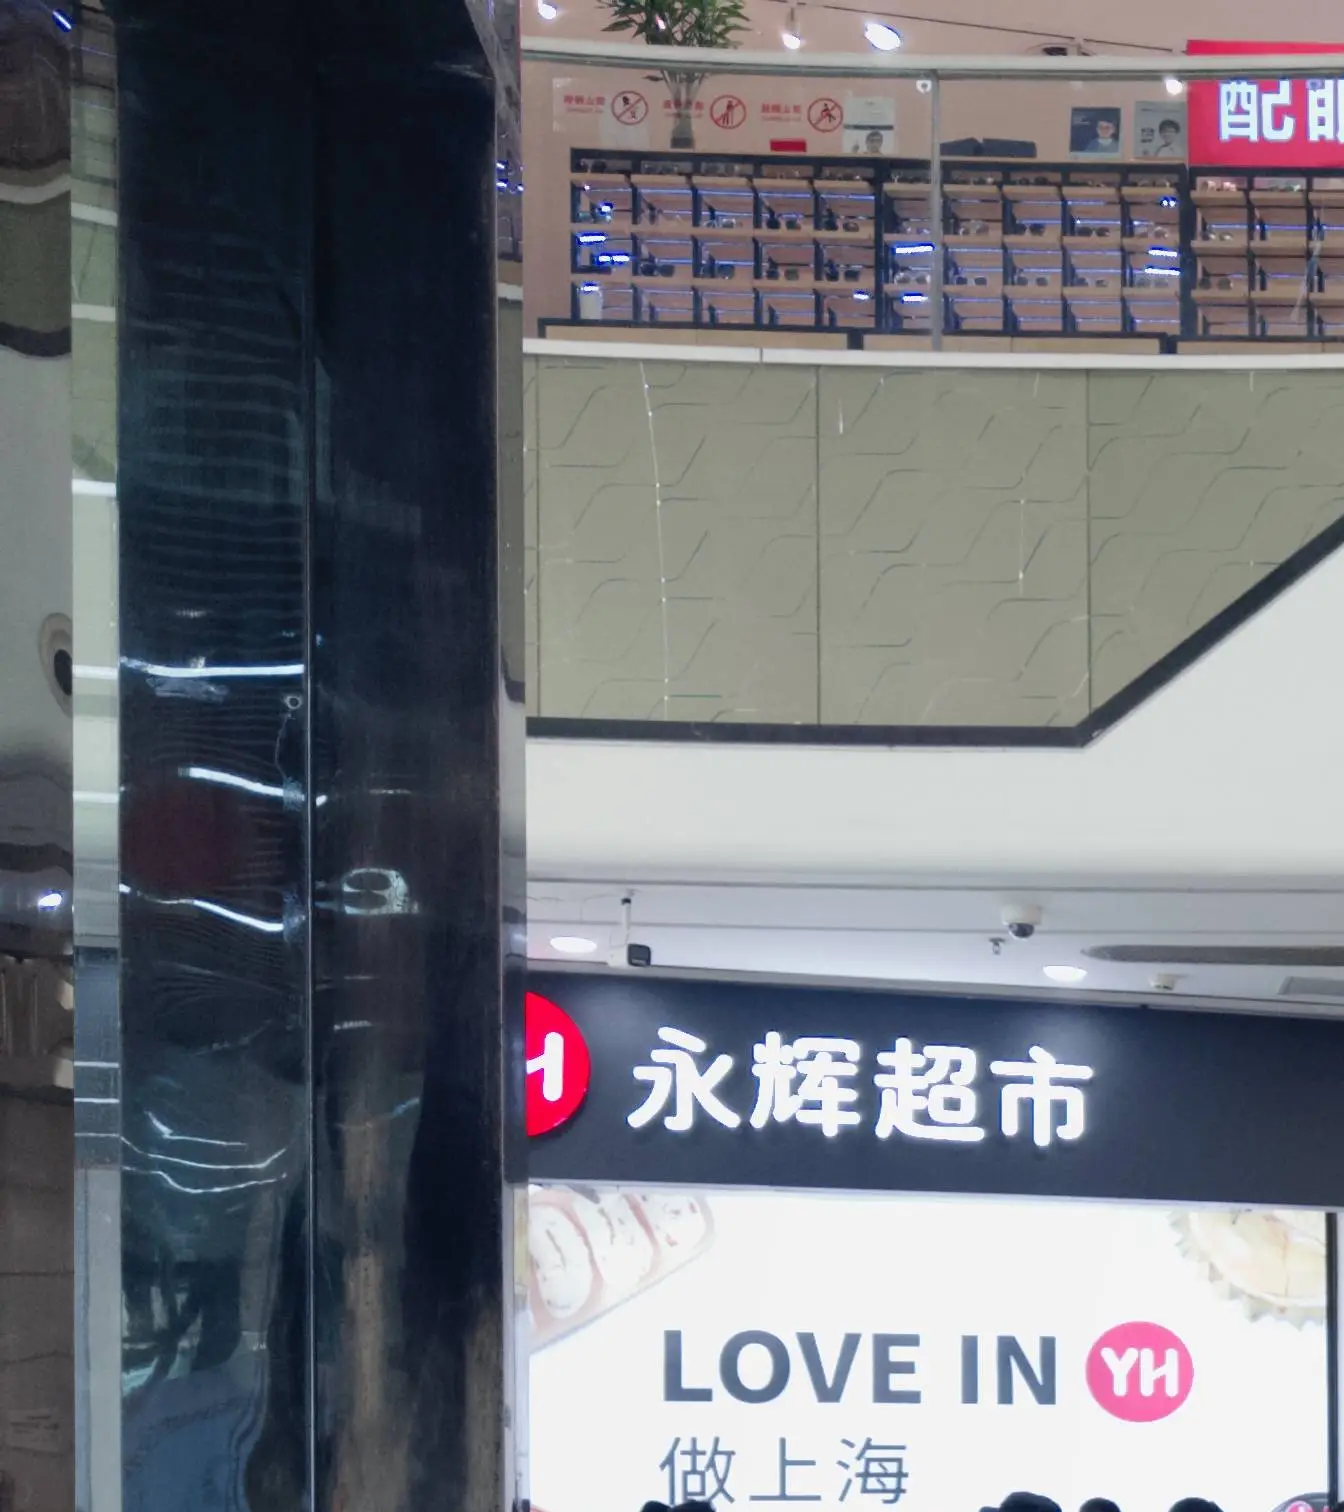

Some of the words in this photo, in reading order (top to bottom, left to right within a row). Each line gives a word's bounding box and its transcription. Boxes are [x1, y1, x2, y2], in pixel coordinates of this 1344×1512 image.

[626, 1026, 1094, 1147] 永辉超市
[663, 1328, 922, 1404] LOVE
[960, 1334, 1058, 1406] IN
[1102, 1344, 1181, 1399] YH
[658, 1435, 910, 1505] 做上海
